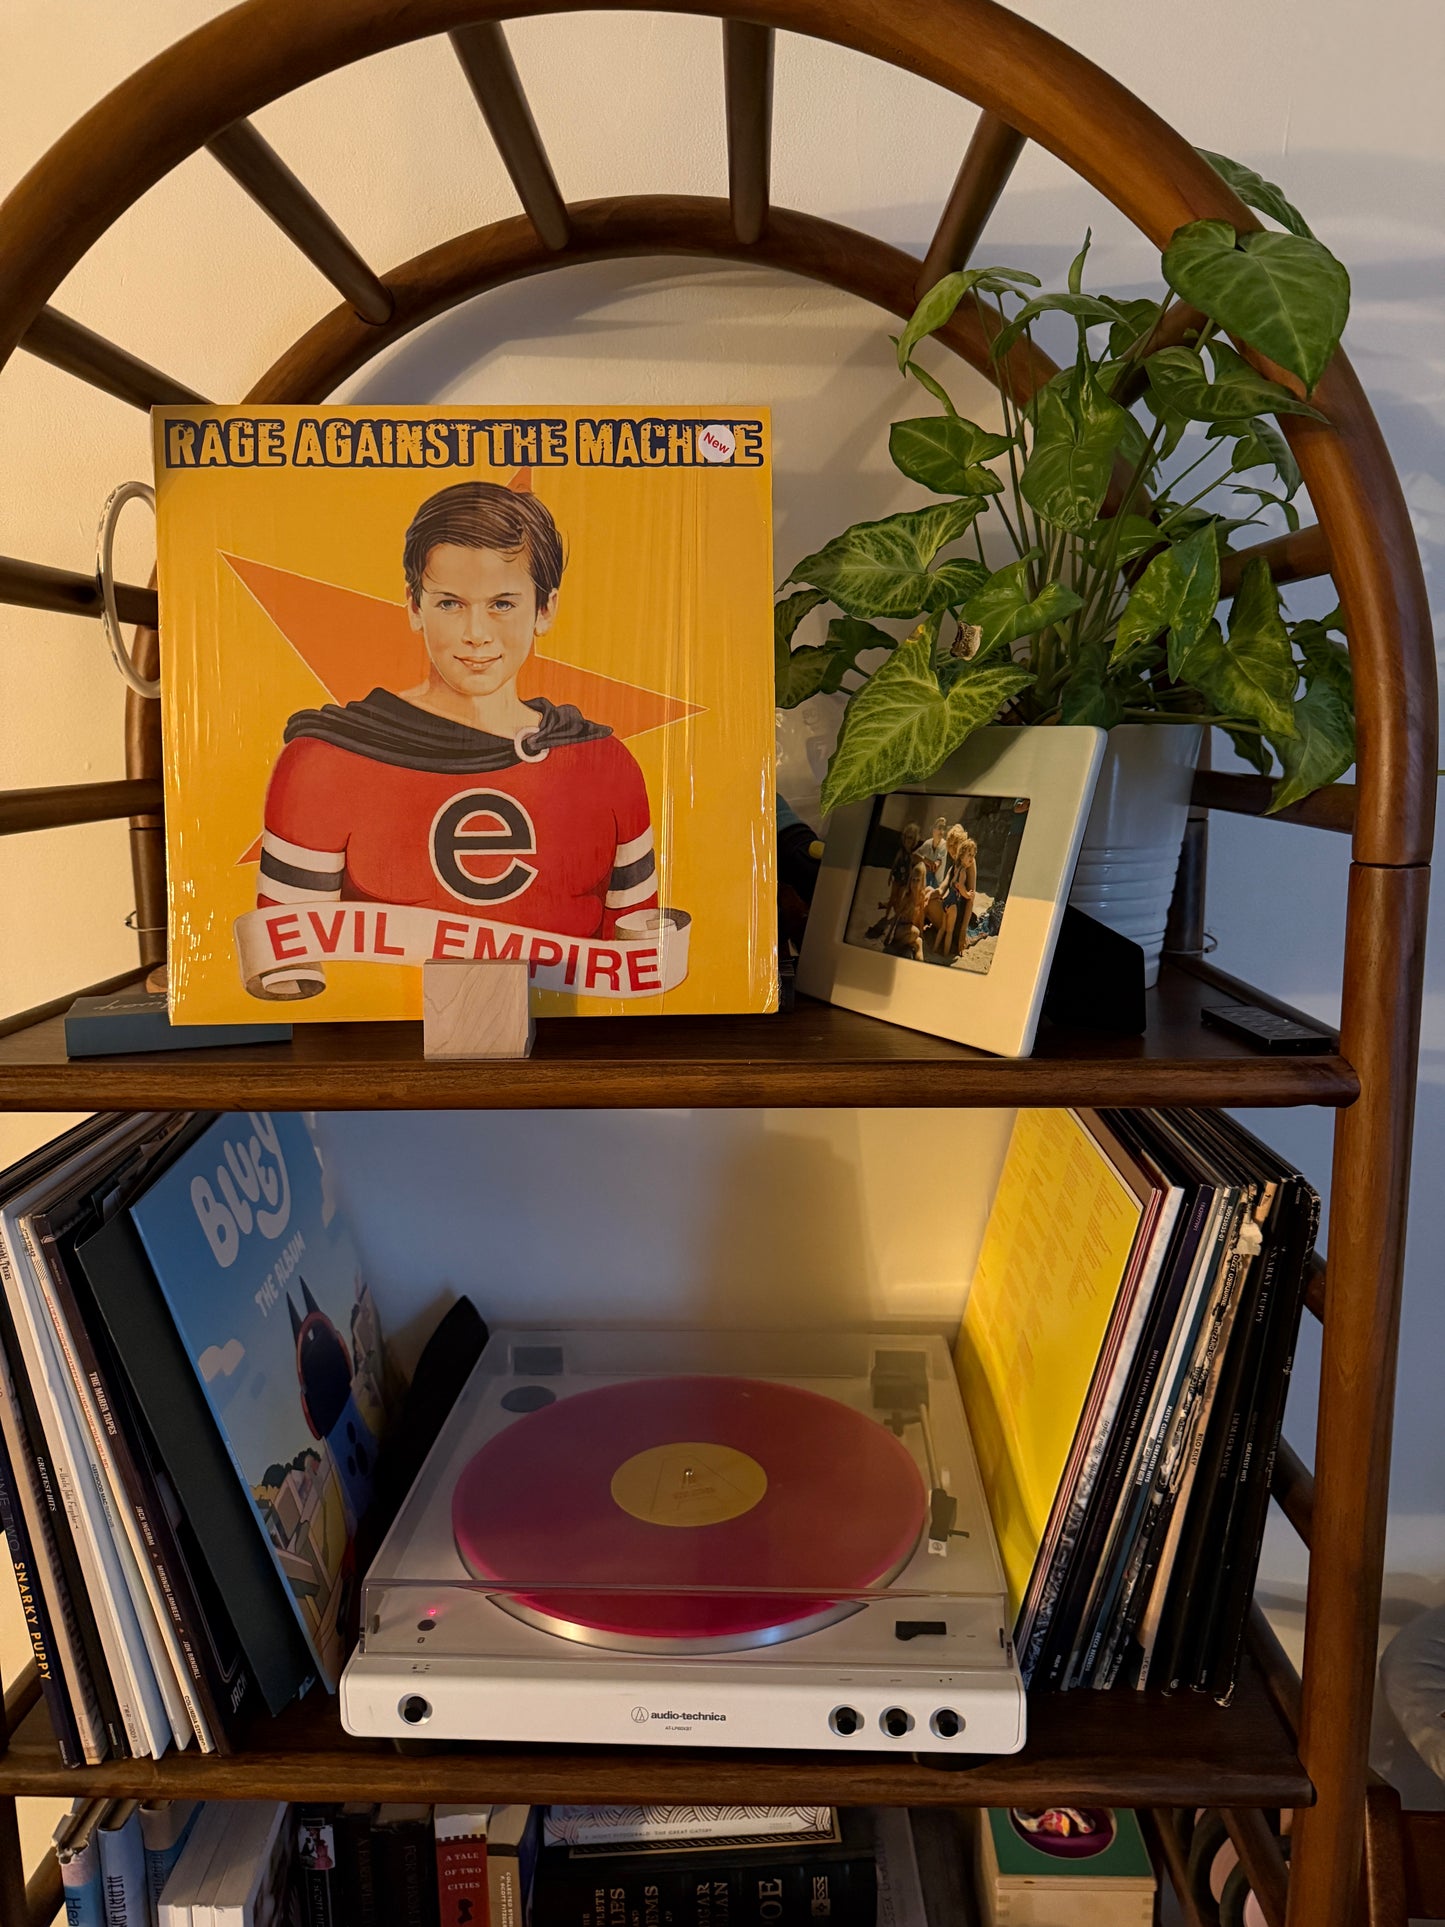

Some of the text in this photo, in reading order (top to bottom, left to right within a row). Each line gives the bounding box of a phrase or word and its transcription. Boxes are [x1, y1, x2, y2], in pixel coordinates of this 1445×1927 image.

[165, 418, 764, 467] RAGE AGAINST THE MACHIE
[703, 430, 731, 455] New
[428, 787, 539, 906] e
[266, 910, 662, 992] EVIL EMPIRE
[190, 1111, 291, 1268] BLUEY
[254, 1230, 306, 1318] THE ALBUM
[1255, 1291, 1269, 1323] PUPPY
[89, 1371, 117, 1436] THE MARFA TAPES
[1164, 1405, 1173, 1422] PATSY
[1157, 1422, 1168, 1442] CLINE'S
[1220, 1413, 1241, 1478] IMMIGRANCE
[1149, 1441, 1161, 1473] GREATEST
[1193, 1433, 1204, 1466] RILO KILEY
[1240, 1442, 1253, 1482] GREATEST HITS
[37, 1456, 57, 1512] GREATEST HITS
[1144, 1473, 1154, 1483] HITS
[100, 1492, 108, 1507] MAC
[3, 1514, 20, 1552] TWO
[135, 1505, 155, 1546] JACK INGRAM
[14, 1561, 52, 1680] SNARKY PUPPY
[166, 1593, 181, 1622] LAMBERT
[183, 1641, 192, 1653] JON
[184, 1695, 198, 1725] COLUMBIA
[651, 1711, 726, 1722] audio-technica
[445, 1866, 482, 1877] OF TWO
[454, 1852, 480, 1861] TALE
[447, 1881, 481, 1891] CITIES
[505, 1871, 513, 1908] COLLECTED
